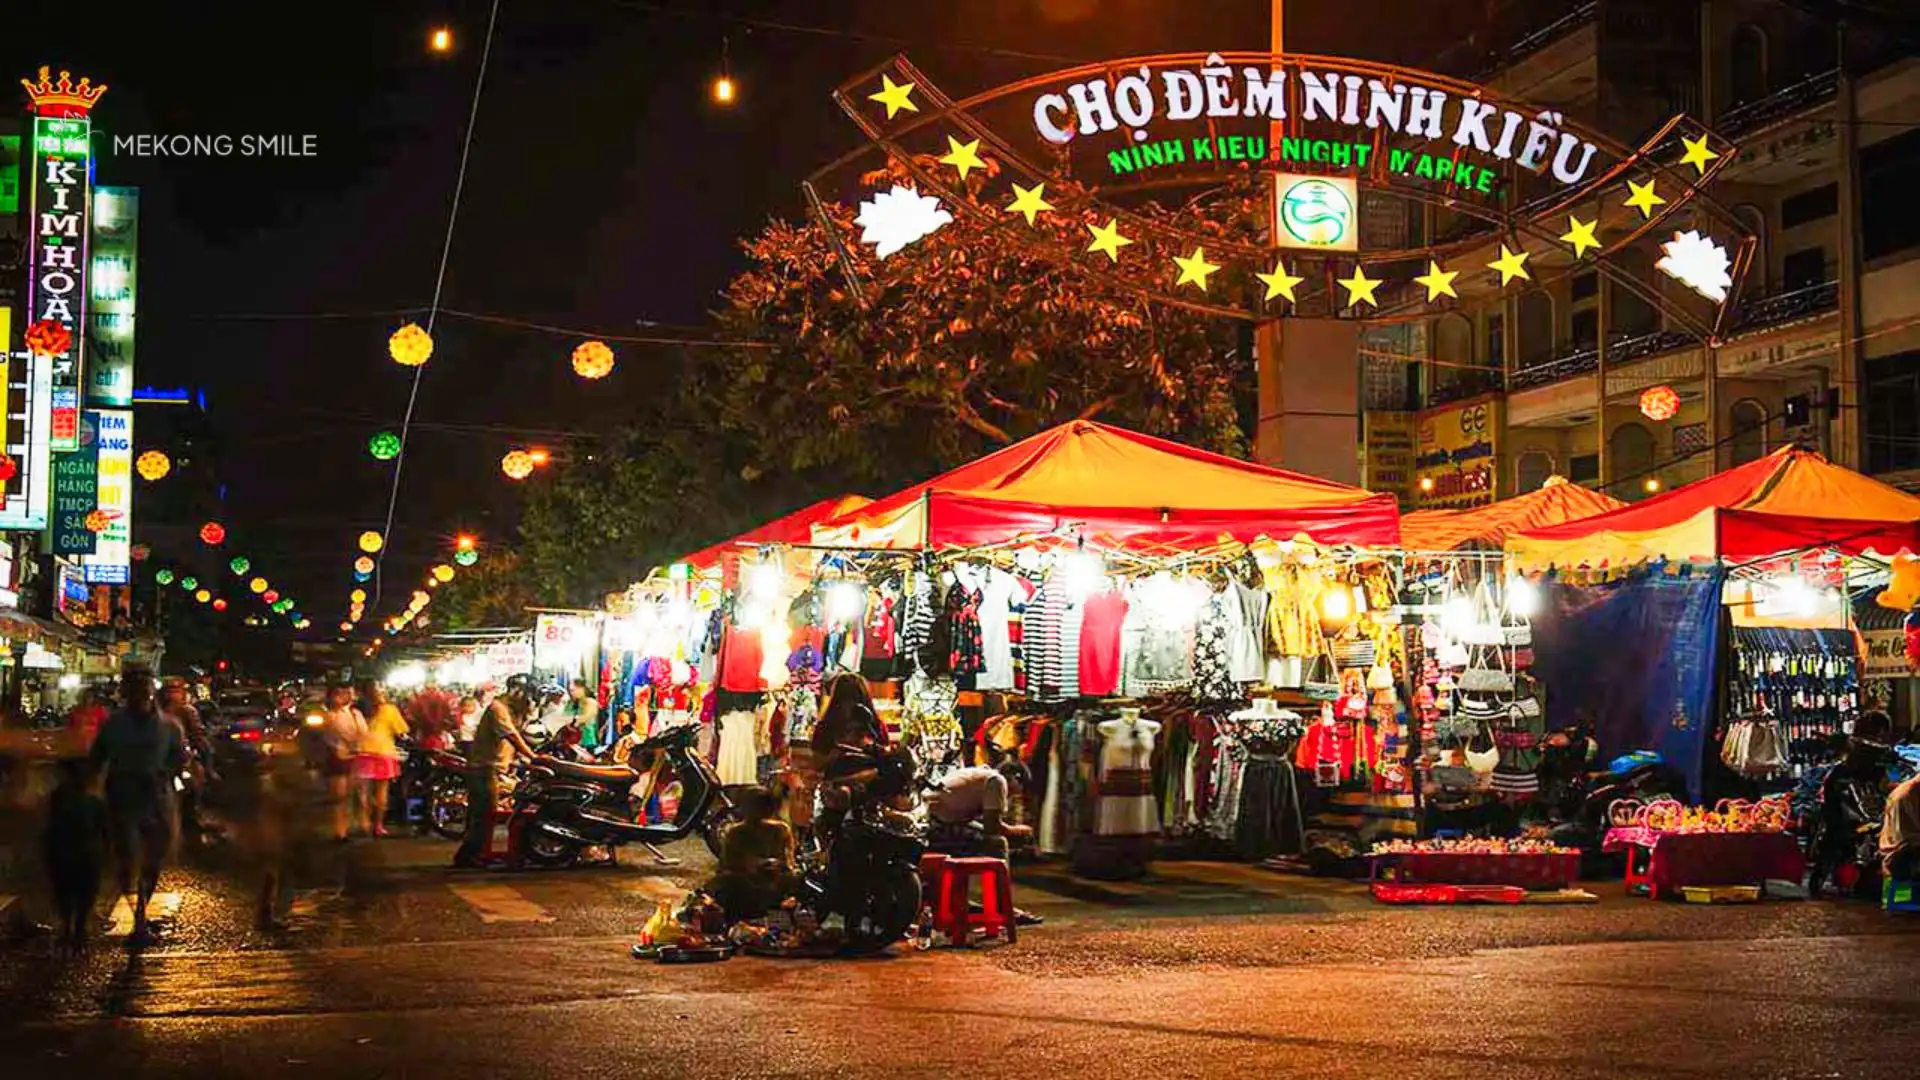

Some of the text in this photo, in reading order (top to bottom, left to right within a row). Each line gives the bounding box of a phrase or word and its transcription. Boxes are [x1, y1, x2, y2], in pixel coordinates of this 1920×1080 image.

[1034, 52, 1597, 184] CHỢ ĐÊM NINH KIỀU
[40, 160, 79, 237] KIM
[1107, 136, 1505, 198] NINH KIEU NIGHT MARKE
[59, 497, 94, 511] TMCP
